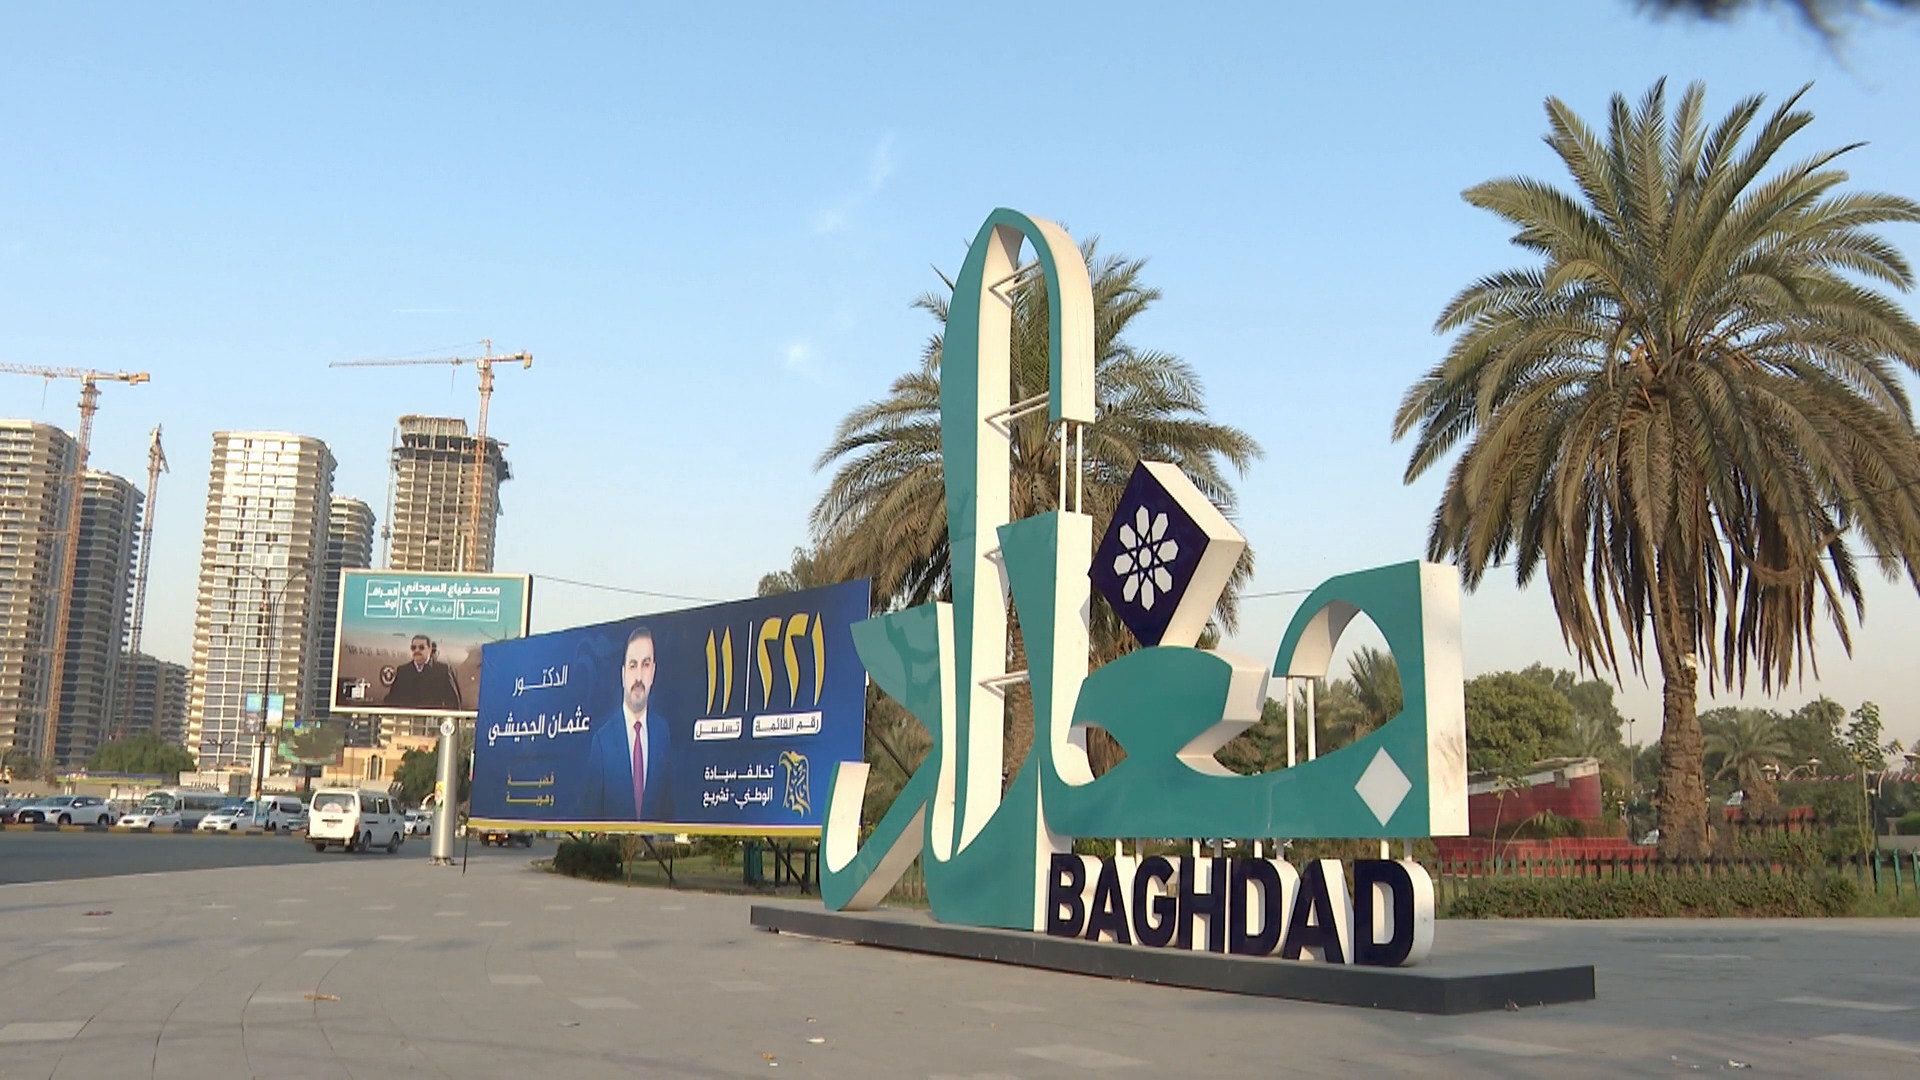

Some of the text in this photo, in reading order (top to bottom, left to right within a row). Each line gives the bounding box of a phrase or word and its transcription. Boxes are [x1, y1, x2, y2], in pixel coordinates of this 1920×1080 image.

[401, 581, 500, 598] محمد شياع السوداني
[405, 600, 429, 615] ٢٠٧
[460, 602, 465, 616] ١
[757, 611, 825, 711] ٢٢١
[512, 664, 568, 696] الدكتور
[488, 705, 590, 746] عثمان الجحيشي
[696, 721, 740, 738] تسلسل
[755, 716, 819, 732] رقم القائمة
[704, 763, 775, 783] تحالف سيادة
[703, 787, 730, 807] تشريع
[735, 786, 773, 810] الوطني
[1047, 853, 1420, 967] BAGHDAD
